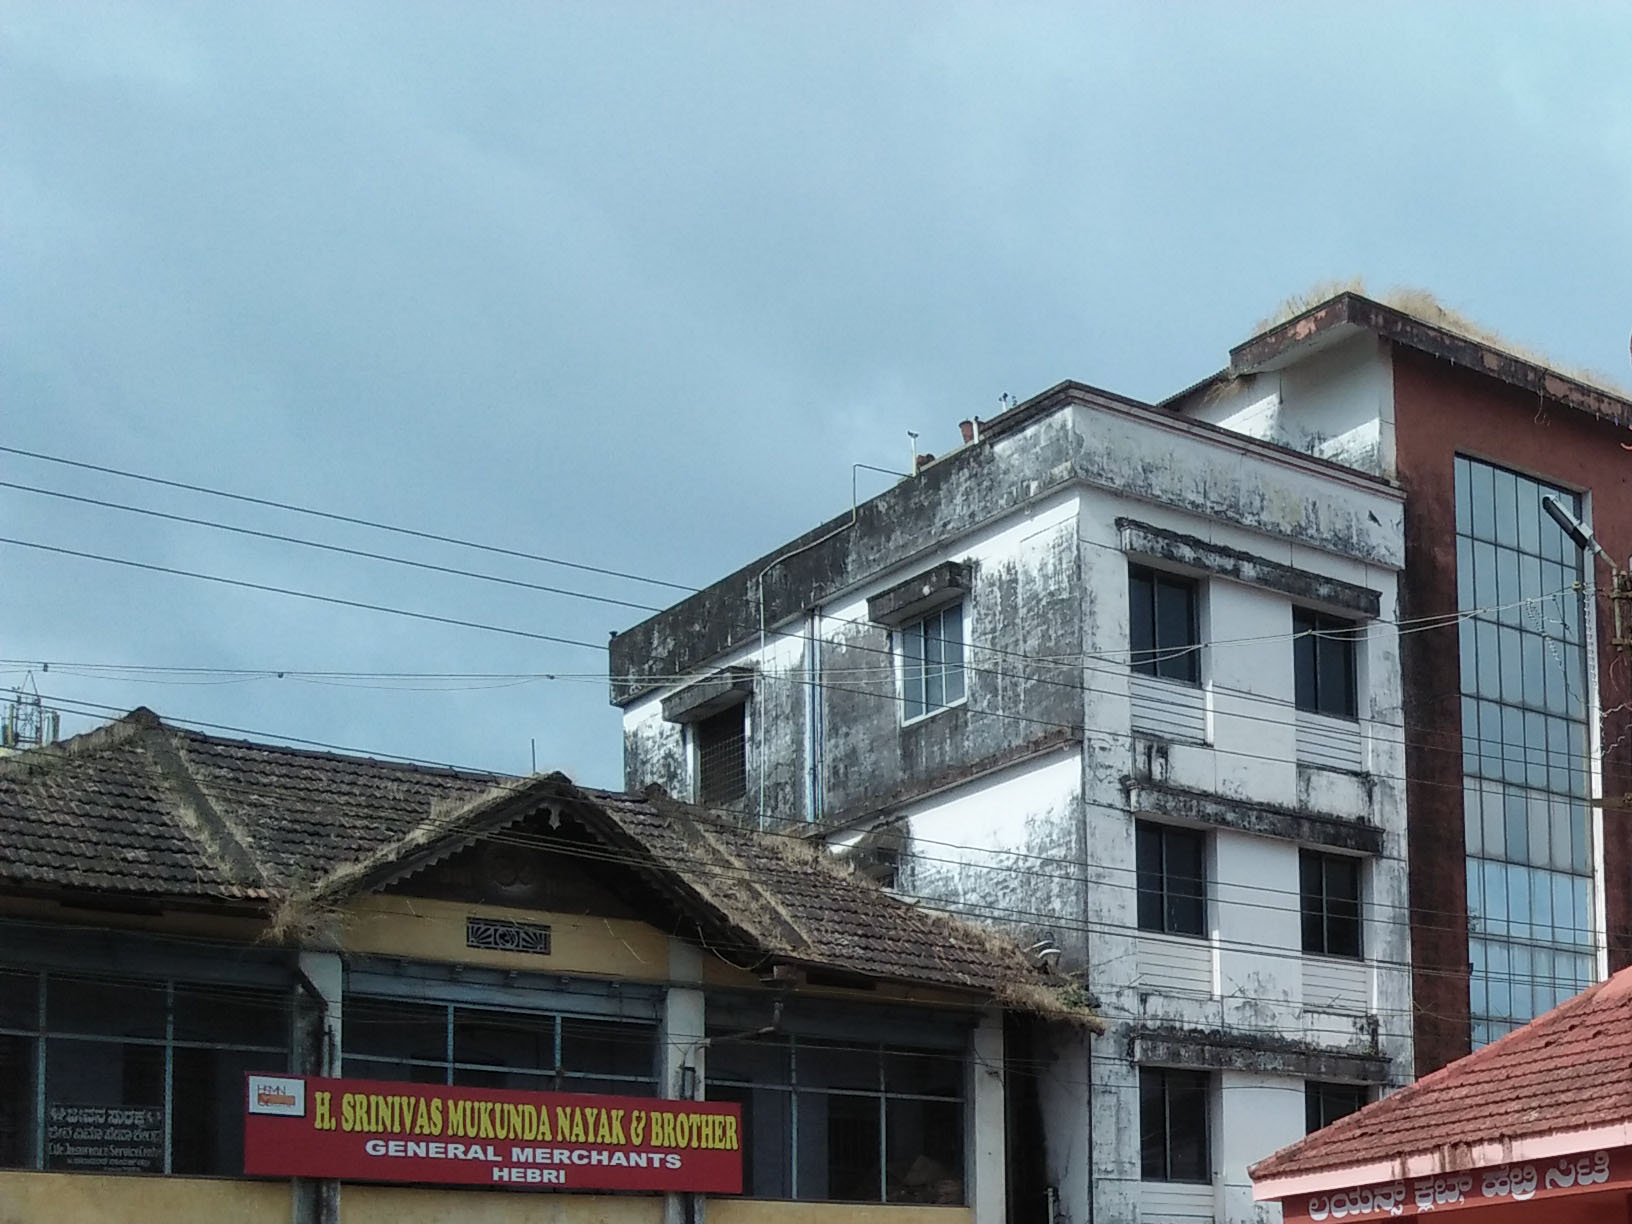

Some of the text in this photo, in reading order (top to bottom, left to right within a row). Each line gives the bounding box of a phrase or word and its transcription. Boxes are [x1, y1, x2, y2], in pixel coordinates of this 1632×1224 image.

[314, 1092, 739, 1149] H. SRINIVAS MUKUNDA NAYAK & BROTHER
[365, 1139, 682, 1169] GENERAL MERCHANTS
[492, 1167, 566, 1184] HEBRI
